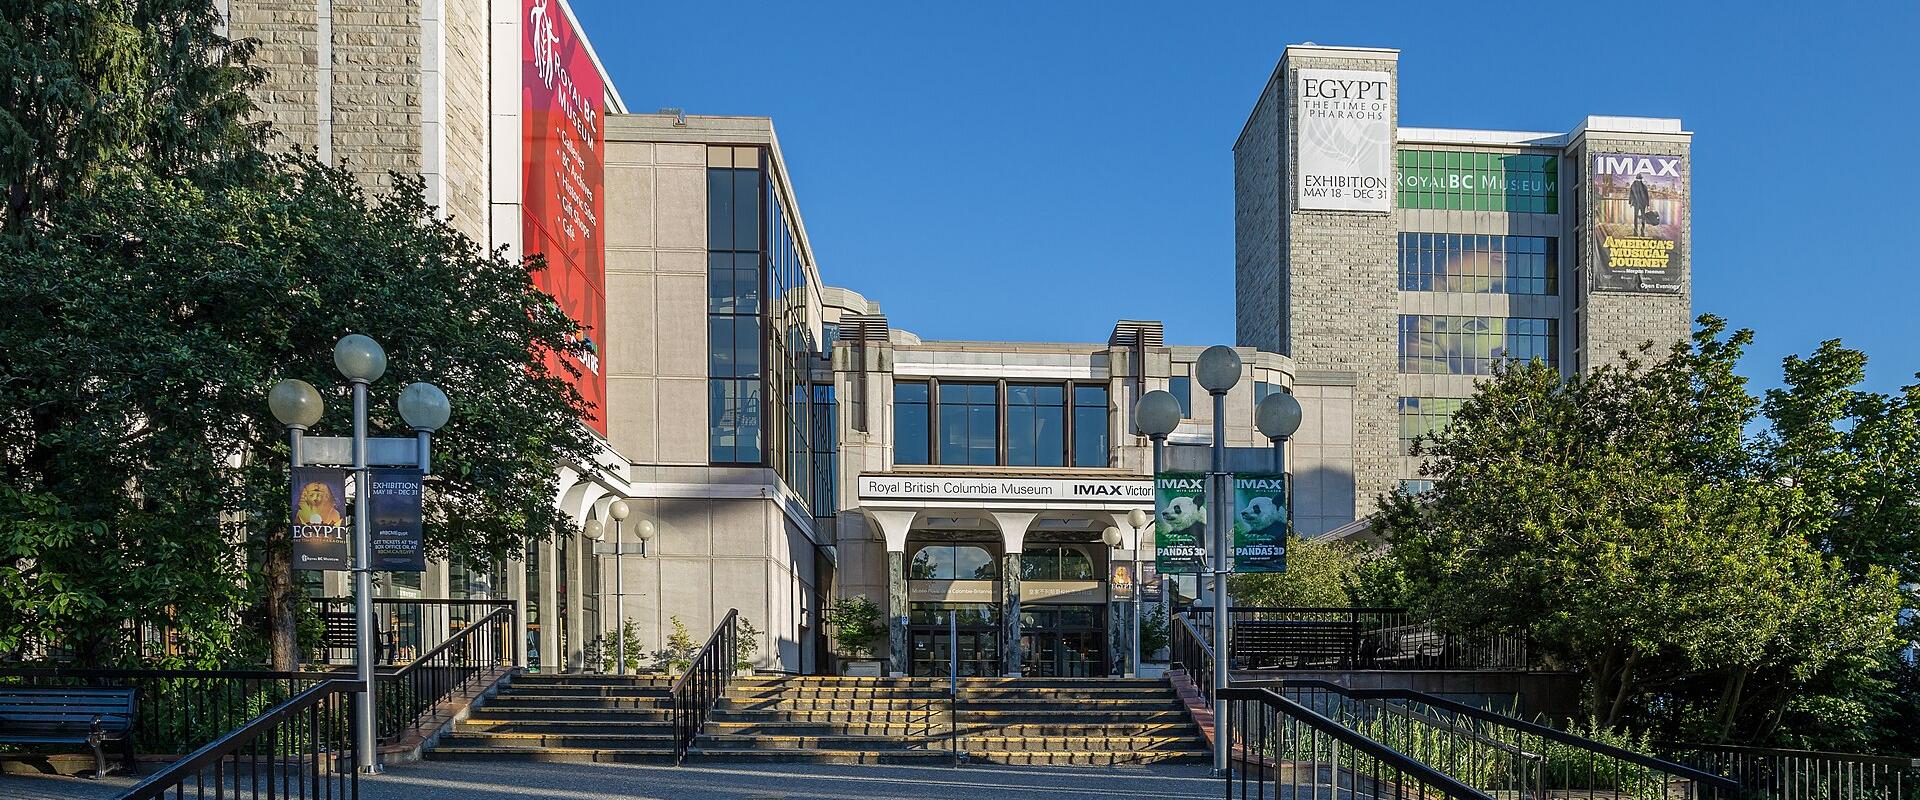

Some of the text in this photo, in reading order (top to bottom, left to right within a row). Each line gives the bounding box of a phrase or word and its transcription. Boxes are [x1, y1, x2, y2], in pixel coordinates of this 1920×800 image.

[554, 50, 596, 133] ROYAL BC
[1303, 79, 1388, 100] EGYPT
[1304, 100, 1388, 112] THE TIME OF
[558, 83, 594, 152] MUSEUM
[1310, 110, 1382, 120] PHARAOHS
[562, 130, 584, 170] Galleries
[1595, 156, 1680, 177] IMAX
[562, 151, 592, 202] BC Archives
[1305, 175, 1387, 188] EXHIBITION
[1397, 172, 1555, 192] ROYAL BC MUSEUM
[562, 173, 584, 210] Historic
[1304, 188, 1328, 197] MAY
[1332, 188, 1342, 198] 18
[1354, 190, 1374, 198] DEC
[1378, 190, 1387, 200] 31
[562, 196, 590, 238] Gift Shops
[1603, 236, 1674, 250] AMERICA'S
[1610, 248, 1669, 258] MUSICAL
[1608, 258, 1669, 268] JOURNEY
[869, 481, 1154, 496] Royal British Columbia Museum IMAX Victori
[1158, 479, 1203, 488] IMAX
[1236, 479, 1282, 489] IMAX
[293, 526, 346, 540] EGYPT
[1156, 548, 1206, 556] PANDAS 3D
[1236, 547, 1284, 556] PANDAS 3D
